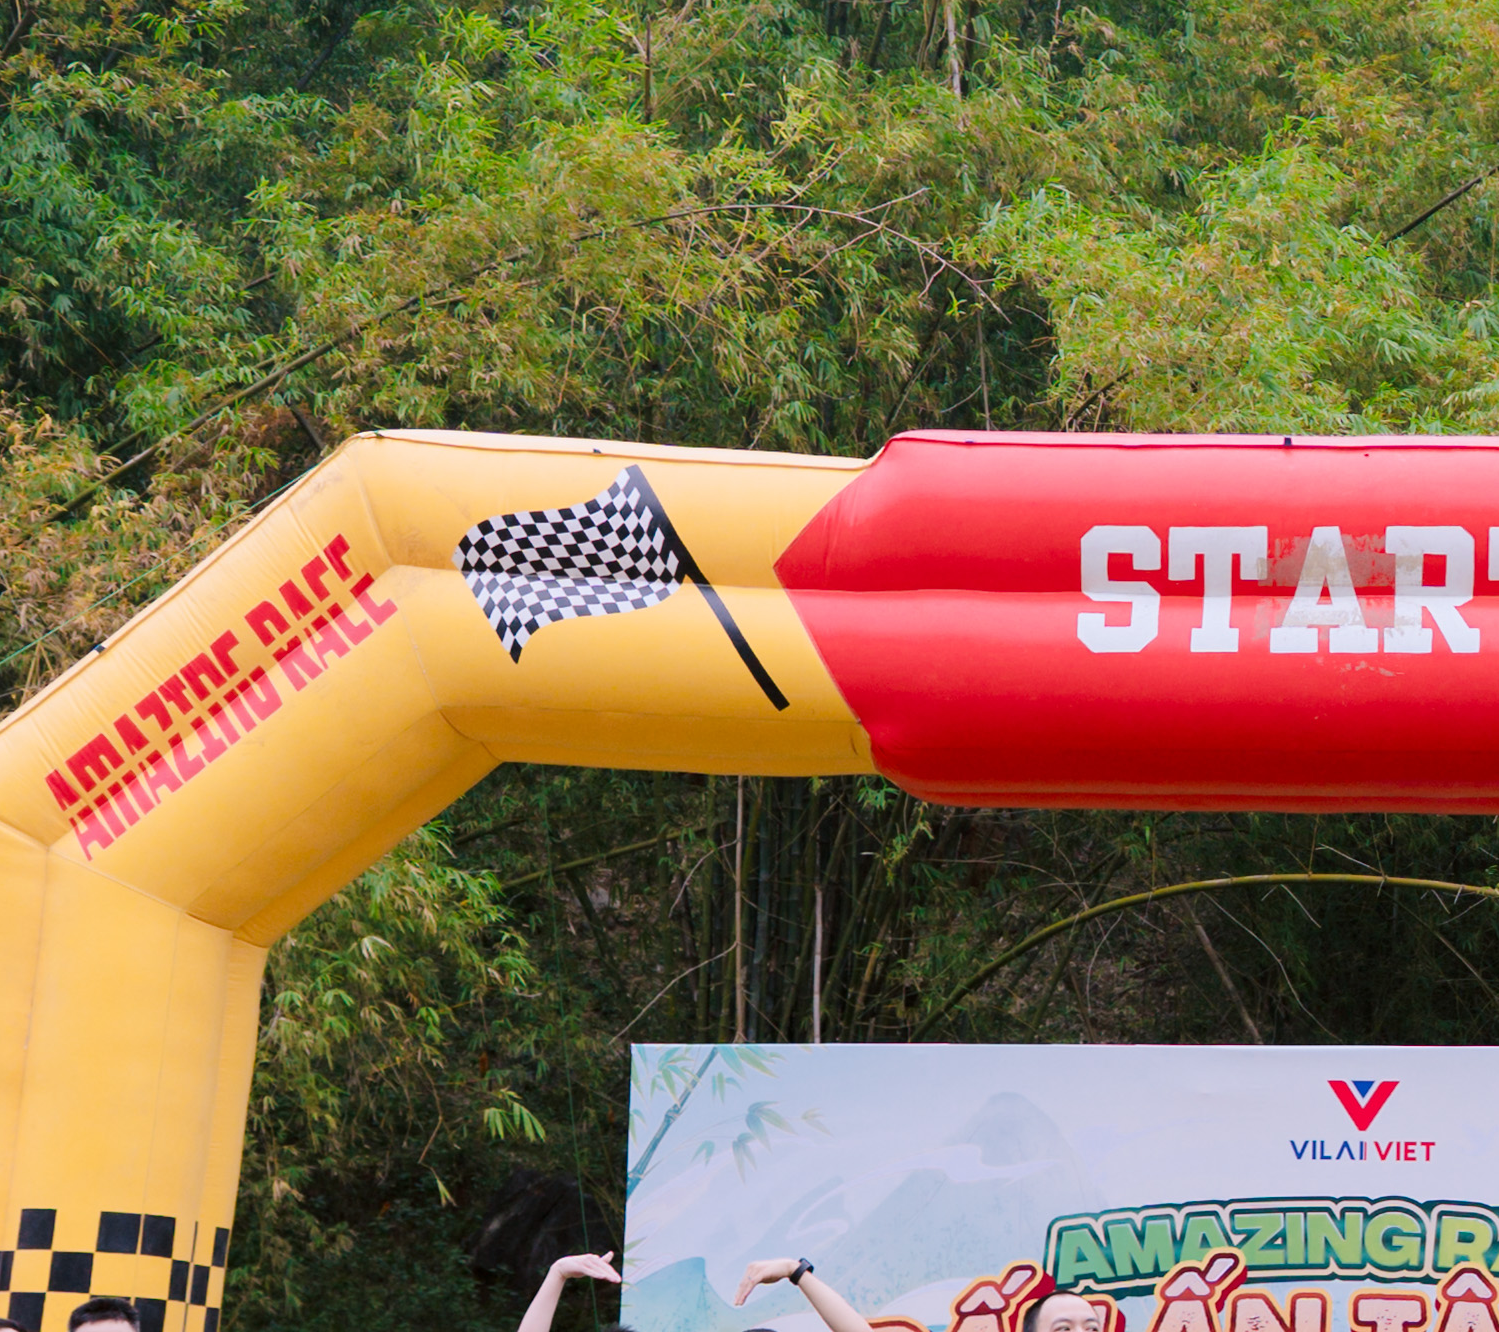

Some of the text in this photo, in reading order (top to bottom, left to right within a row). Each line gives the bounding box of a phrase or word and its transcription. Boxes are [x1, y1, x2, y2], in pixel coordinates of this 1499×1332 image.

[44, 532, 399, 862] AMAZING RACE
[1053, 1210, 1422, 1286] AMAZING
